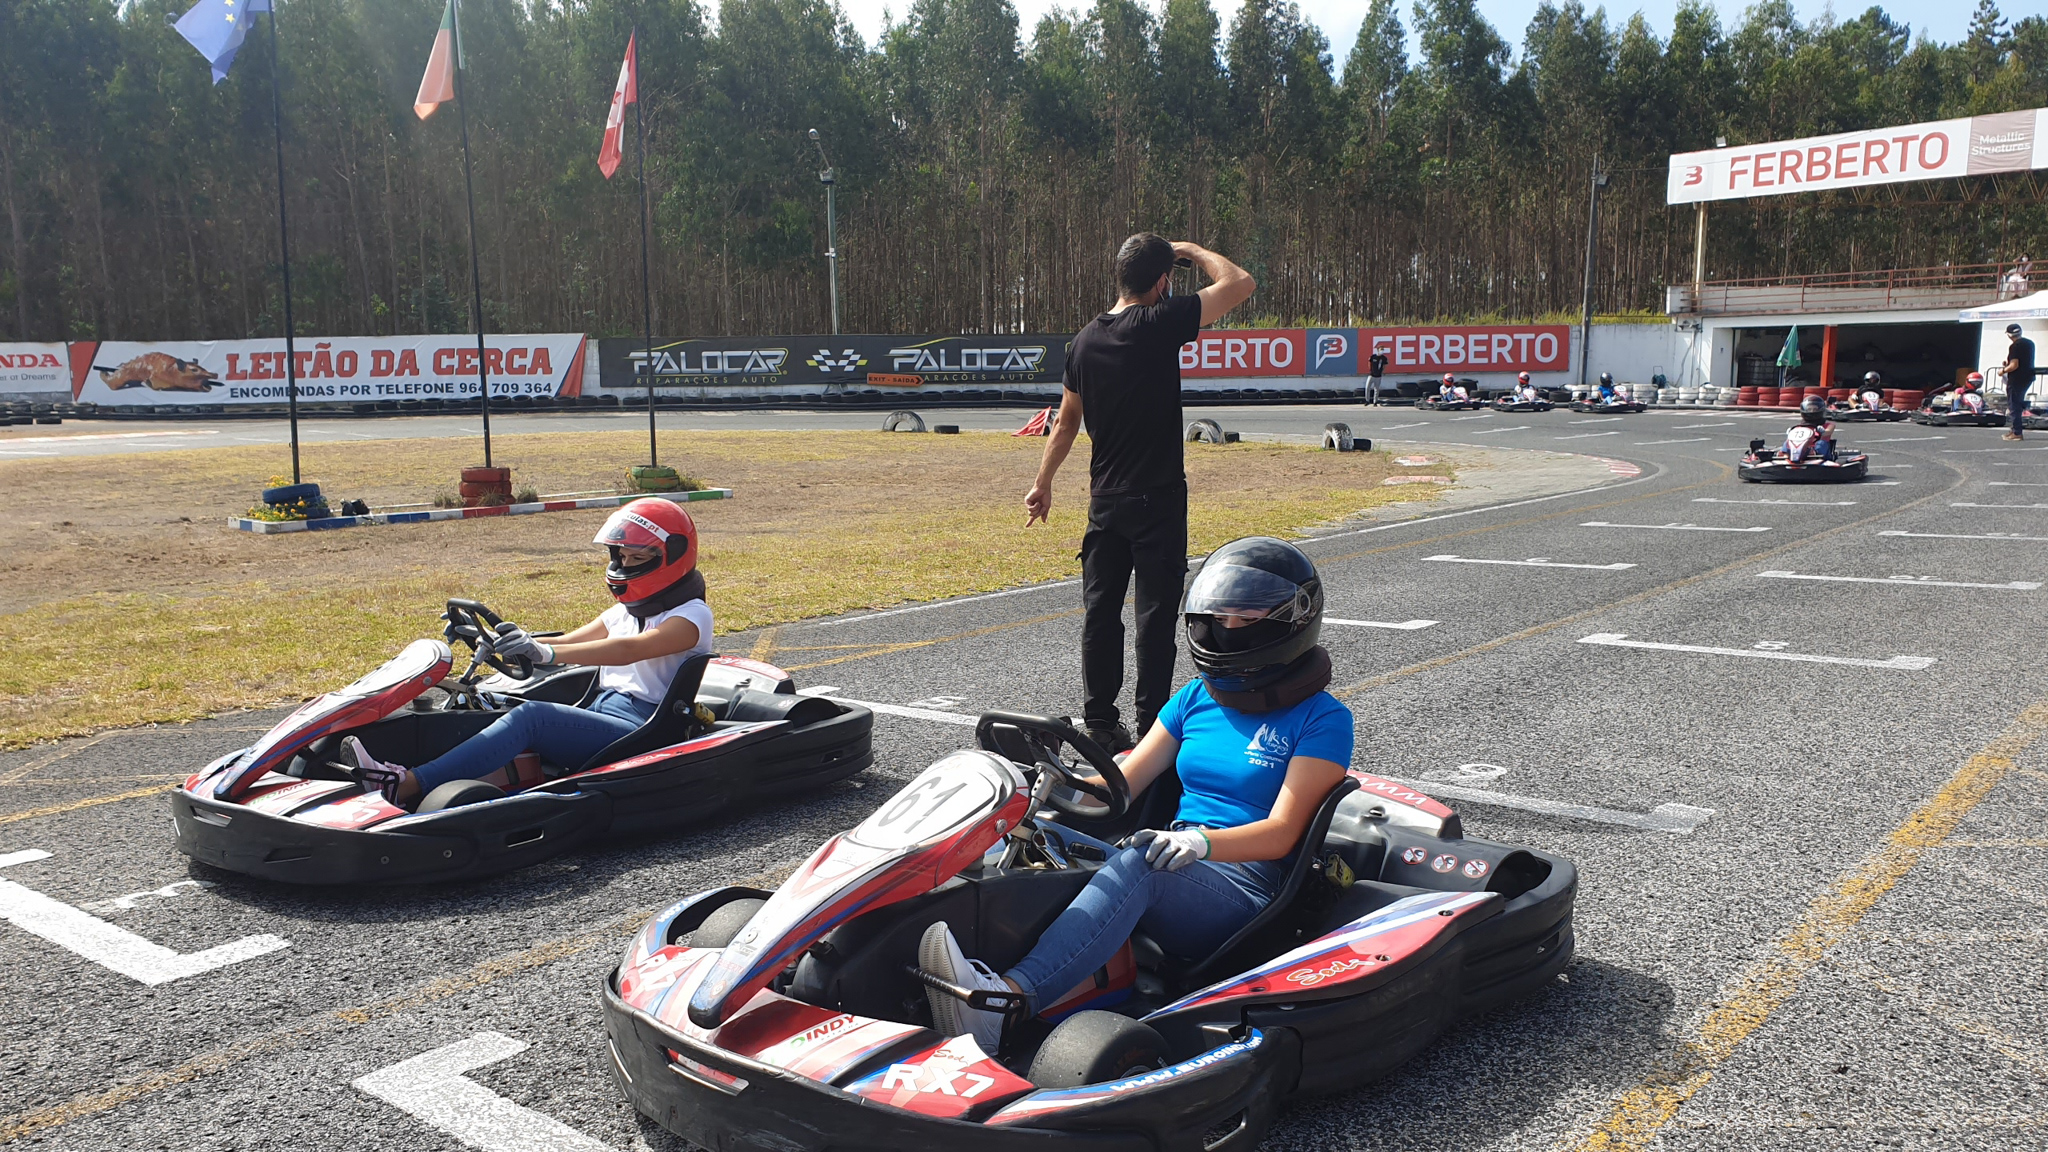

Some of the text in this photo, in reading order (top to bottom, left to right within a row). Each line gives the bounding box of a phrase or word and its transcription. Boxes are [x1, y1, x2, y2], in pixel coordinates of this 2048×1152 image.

[1979, 131, 2025, 145] Metallic
[1971, 142, 2032, 156] Structures
[1728, 131, 1950, 190] FERBERTO
[1179, 337, 1293, 370] BERTO
[1372, 332, 1558, 366] FERBERTO
[0, 353, 62, 369] NDA
[225, 341, 553, 381] LEITÃO DA CERCA
[628, 350, 786, 375] PALOCAR
[888, 347, 1044, 372] PALOCAR
[21, 372, 57, 381] Dreams
[636, 375, 778, 386] RPARAÇÕES AUTO
[1000, 373, 1035, 382] AUTO
[340, 384, 372, 396] POR
[376, 382, 455, 396] TELEFONE
[491, 382, 520, 394] 709
[524, 382, 553, 394] 364
[1247, 757, 1275, 769] 2021
[877, 776, 969, 835] 61
[881, 1063, 996, 1099] RX7
